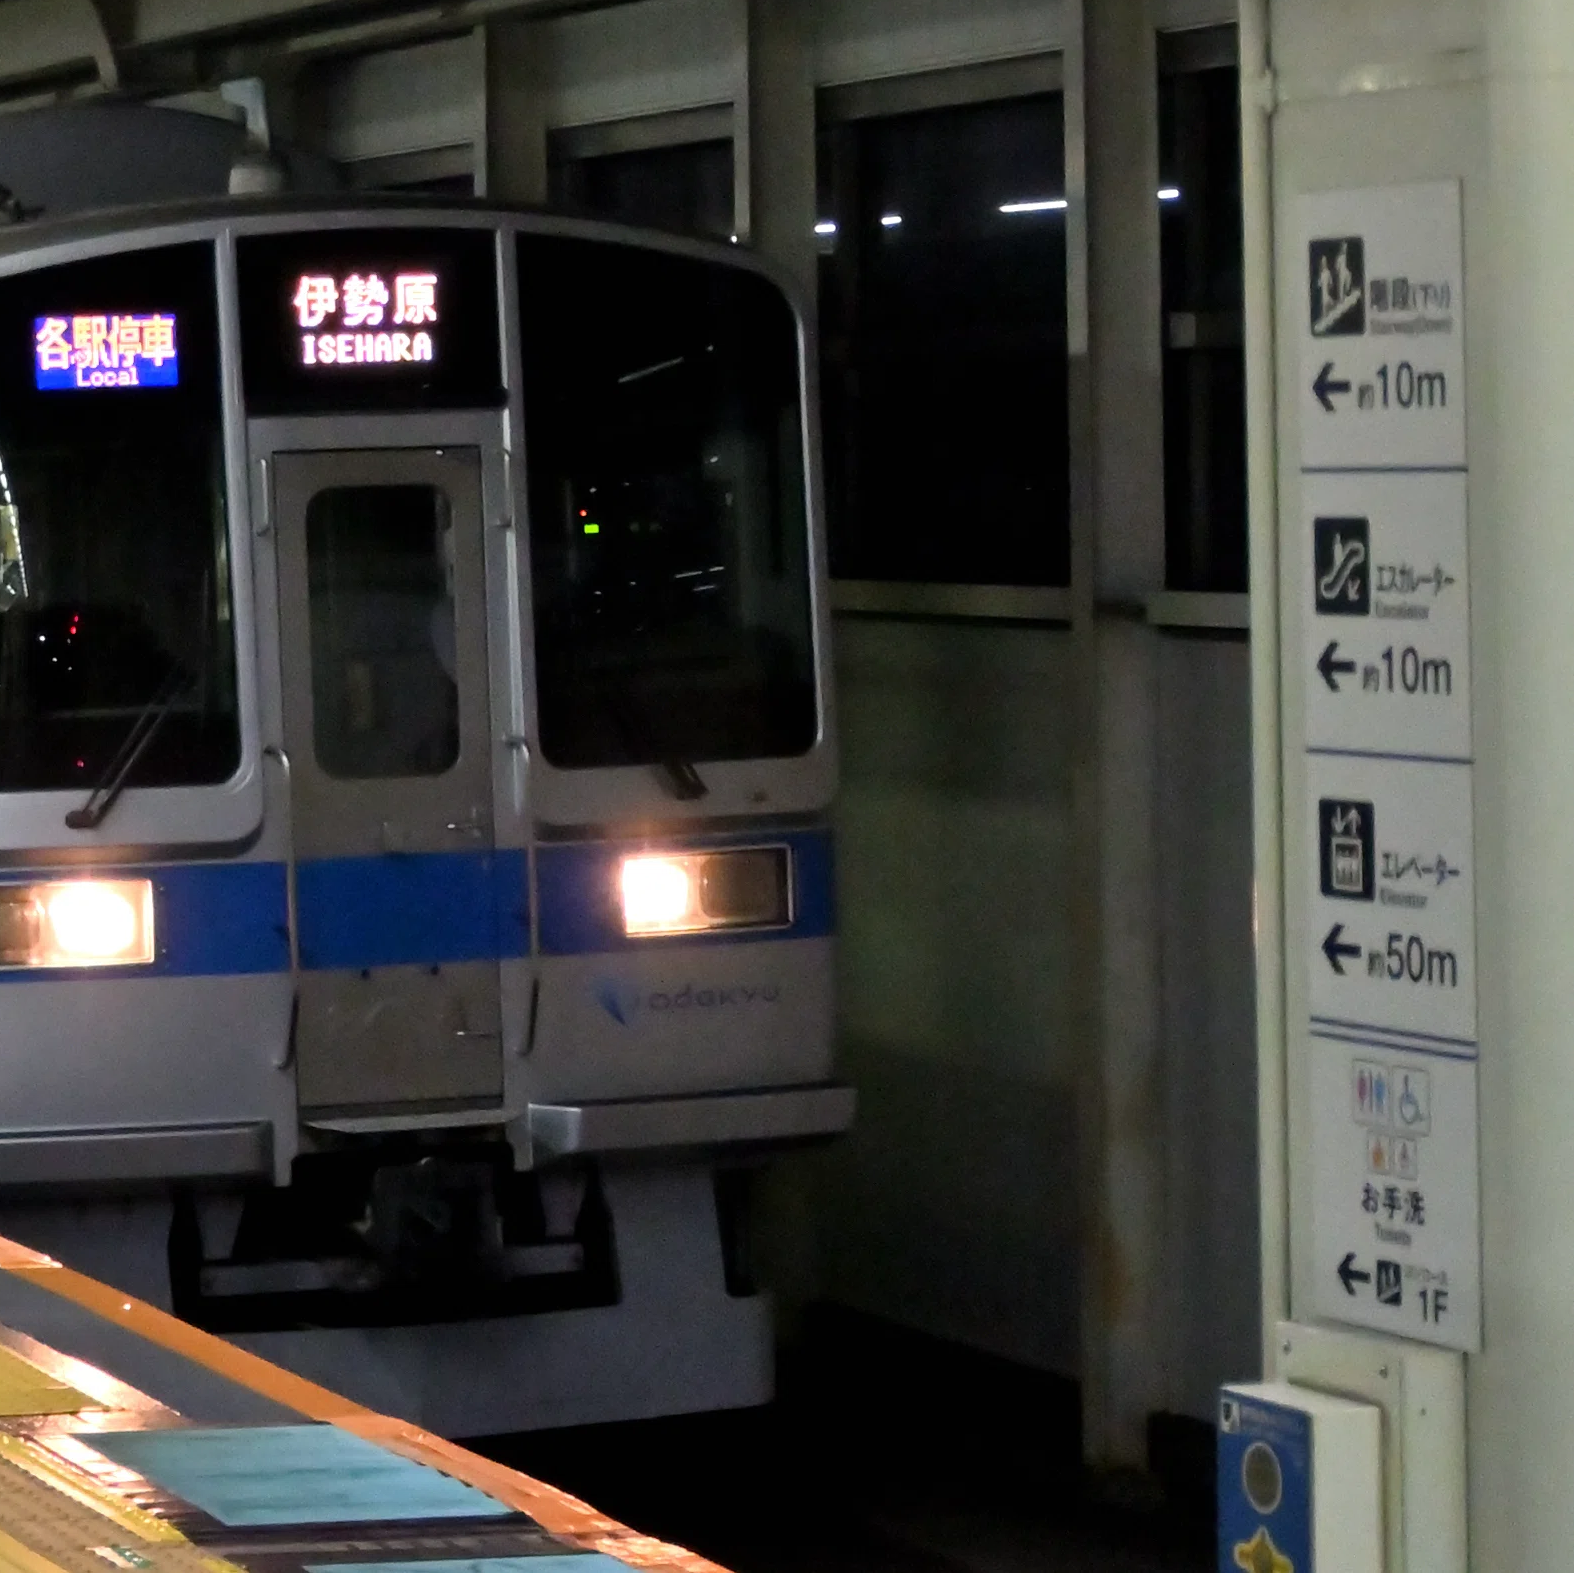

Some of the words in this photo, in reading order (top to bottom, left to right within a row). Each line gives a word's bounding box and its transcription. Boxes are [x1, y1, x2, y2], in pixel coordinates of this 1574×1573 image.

[293, 273, 439, 328] 伊勢原
[35, 314, 176, 370] 各駅停車
[302, 332, 434, 365] ISEHARA
[75, 366, 140, 388] Local
[1418, 1288, 1449, 1324] 1F
